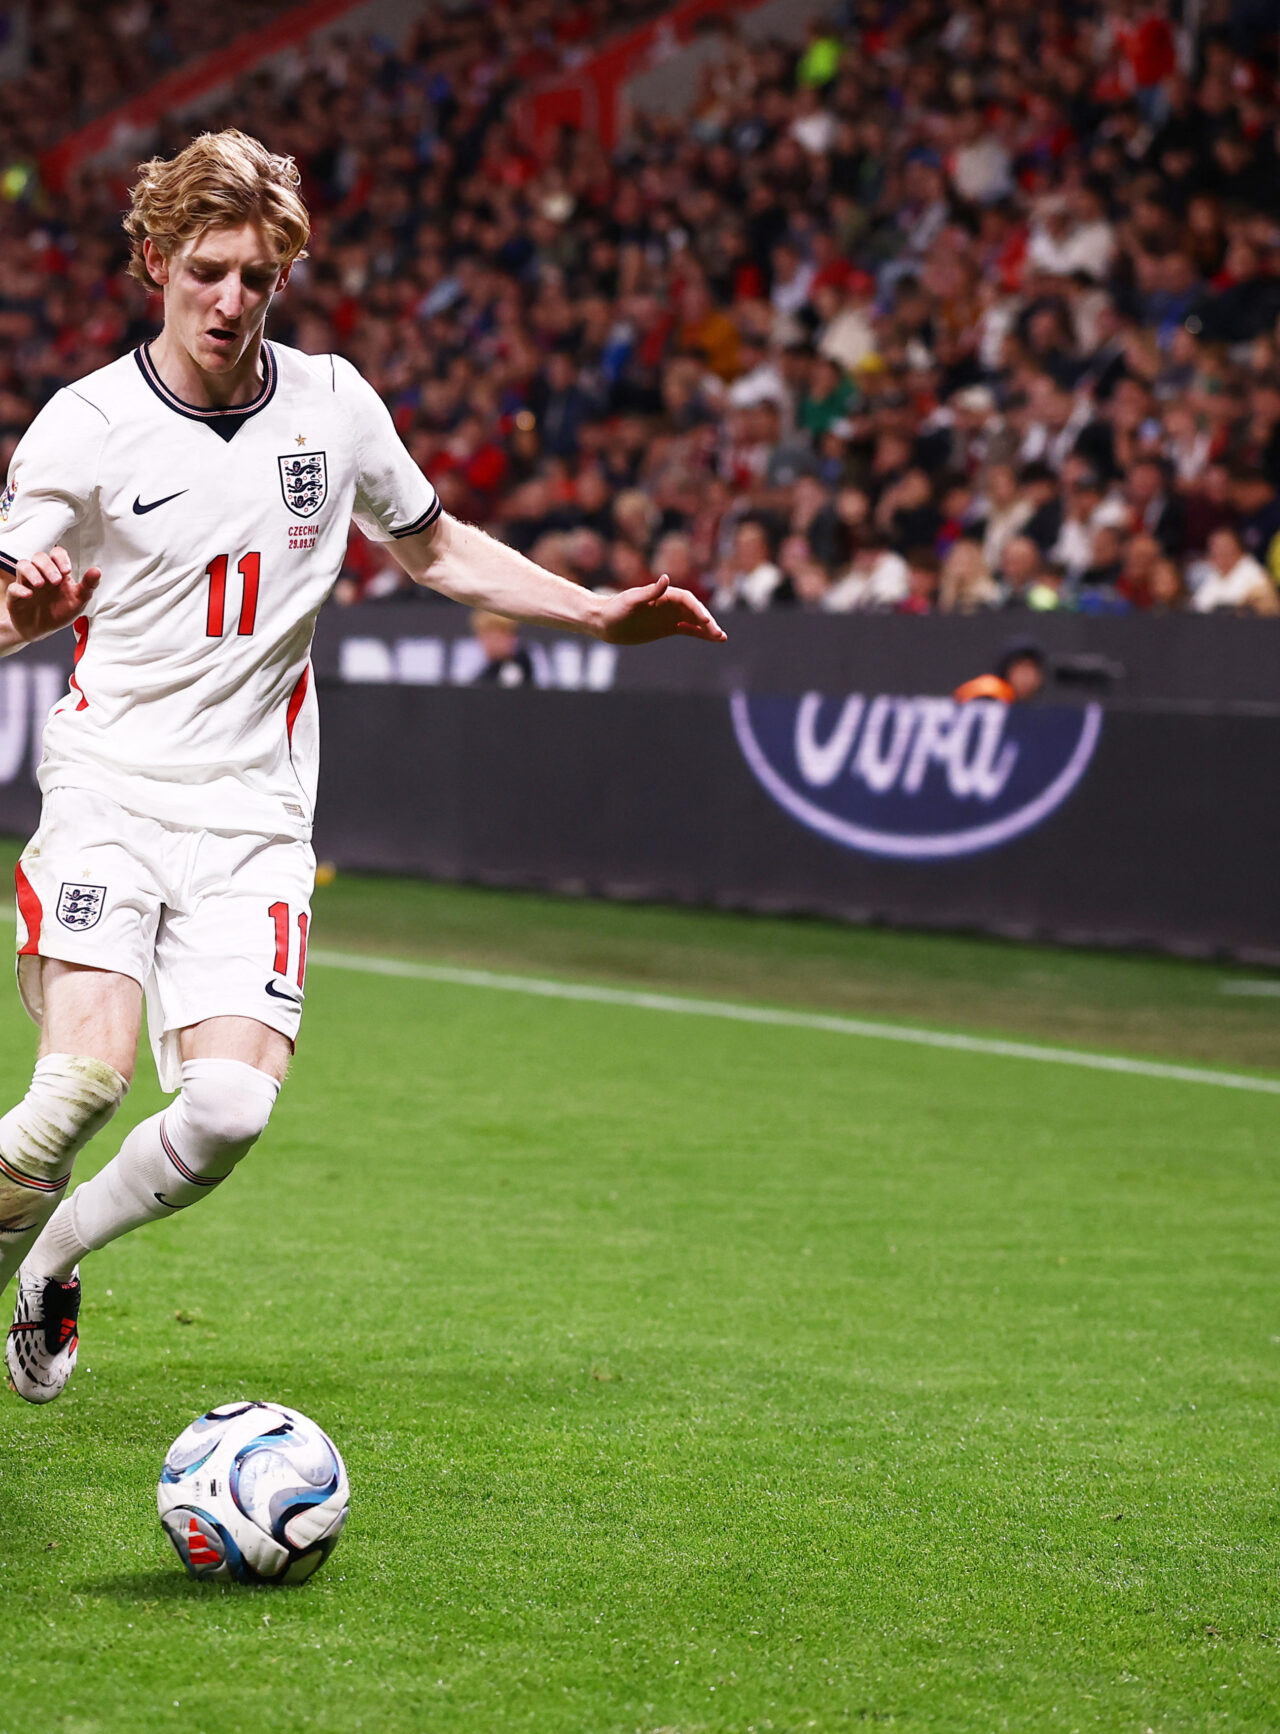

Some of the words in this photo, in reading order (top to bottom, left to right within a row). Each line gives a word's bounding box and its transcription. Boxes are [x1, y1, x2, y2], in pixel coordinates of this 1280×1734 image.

[288, 524, 320, 537] CZECHIA
[205, 551, 261, 638] 11
[267, 900, 309, 991] 11
